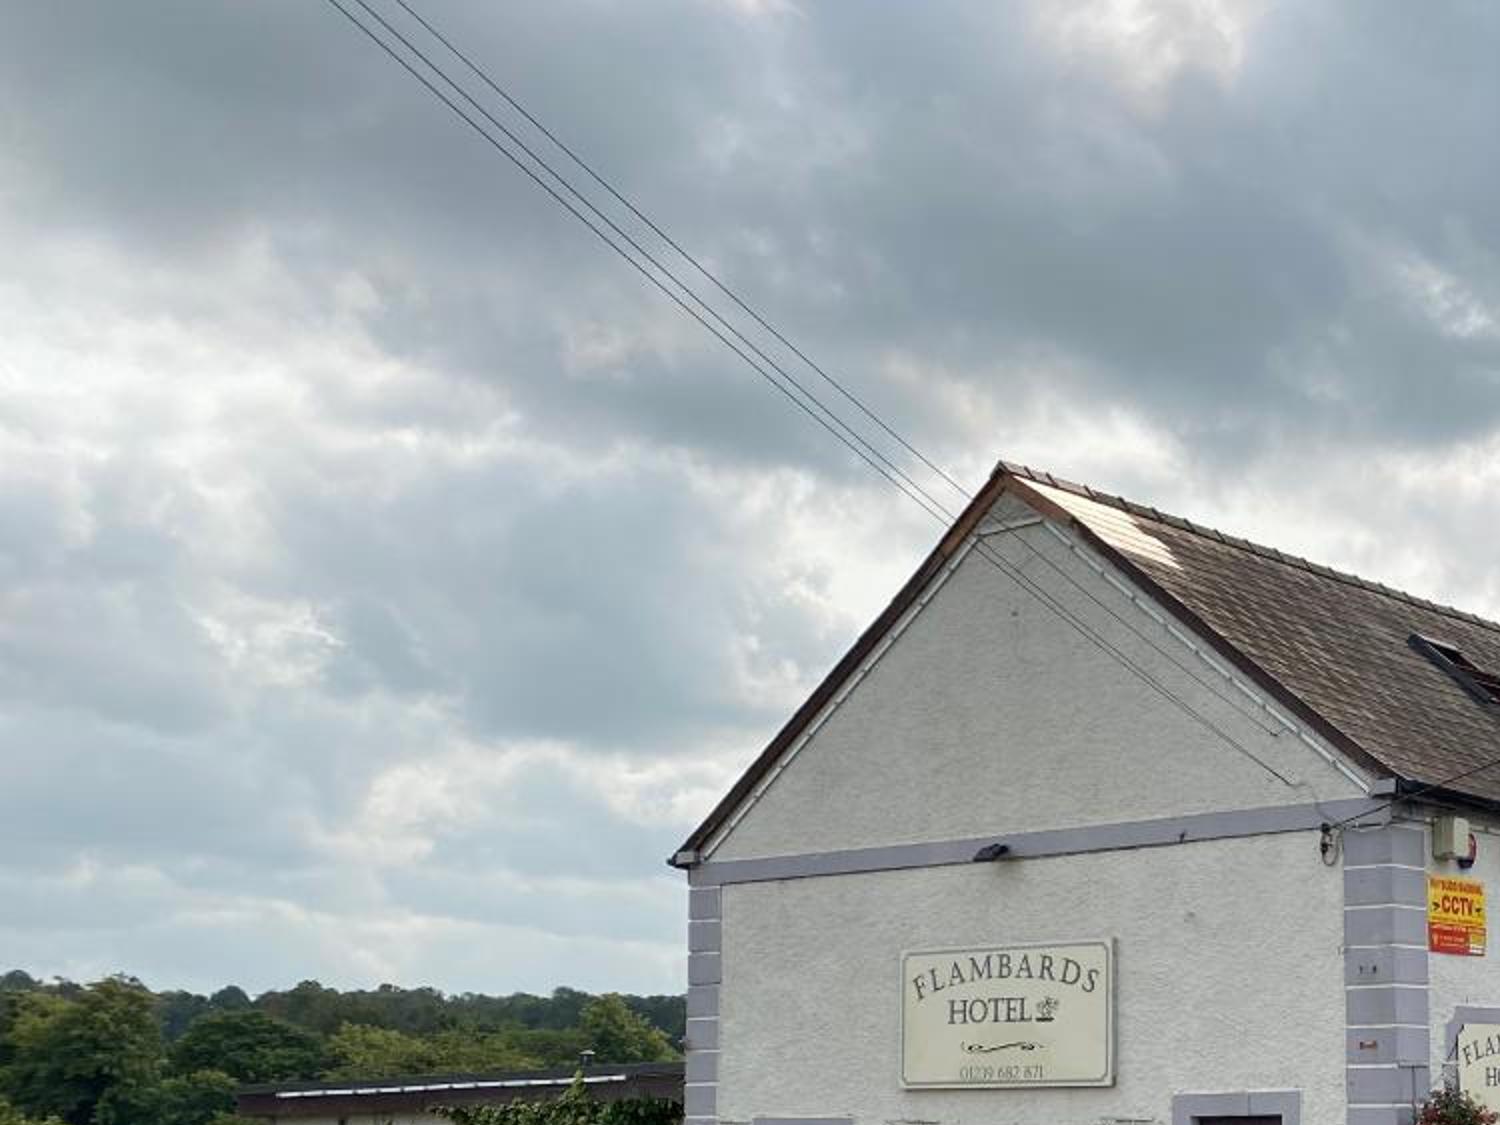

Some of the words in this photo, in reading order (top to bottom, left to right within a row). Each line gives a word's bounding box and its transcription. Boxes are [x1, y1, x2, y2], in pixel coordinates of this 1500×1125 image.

[1441, 894, 1474, 916] CCTV
[912, 953, 1100, 1001] FLAMBARDS
[947, 997, 1032, 1025] HOTEL
